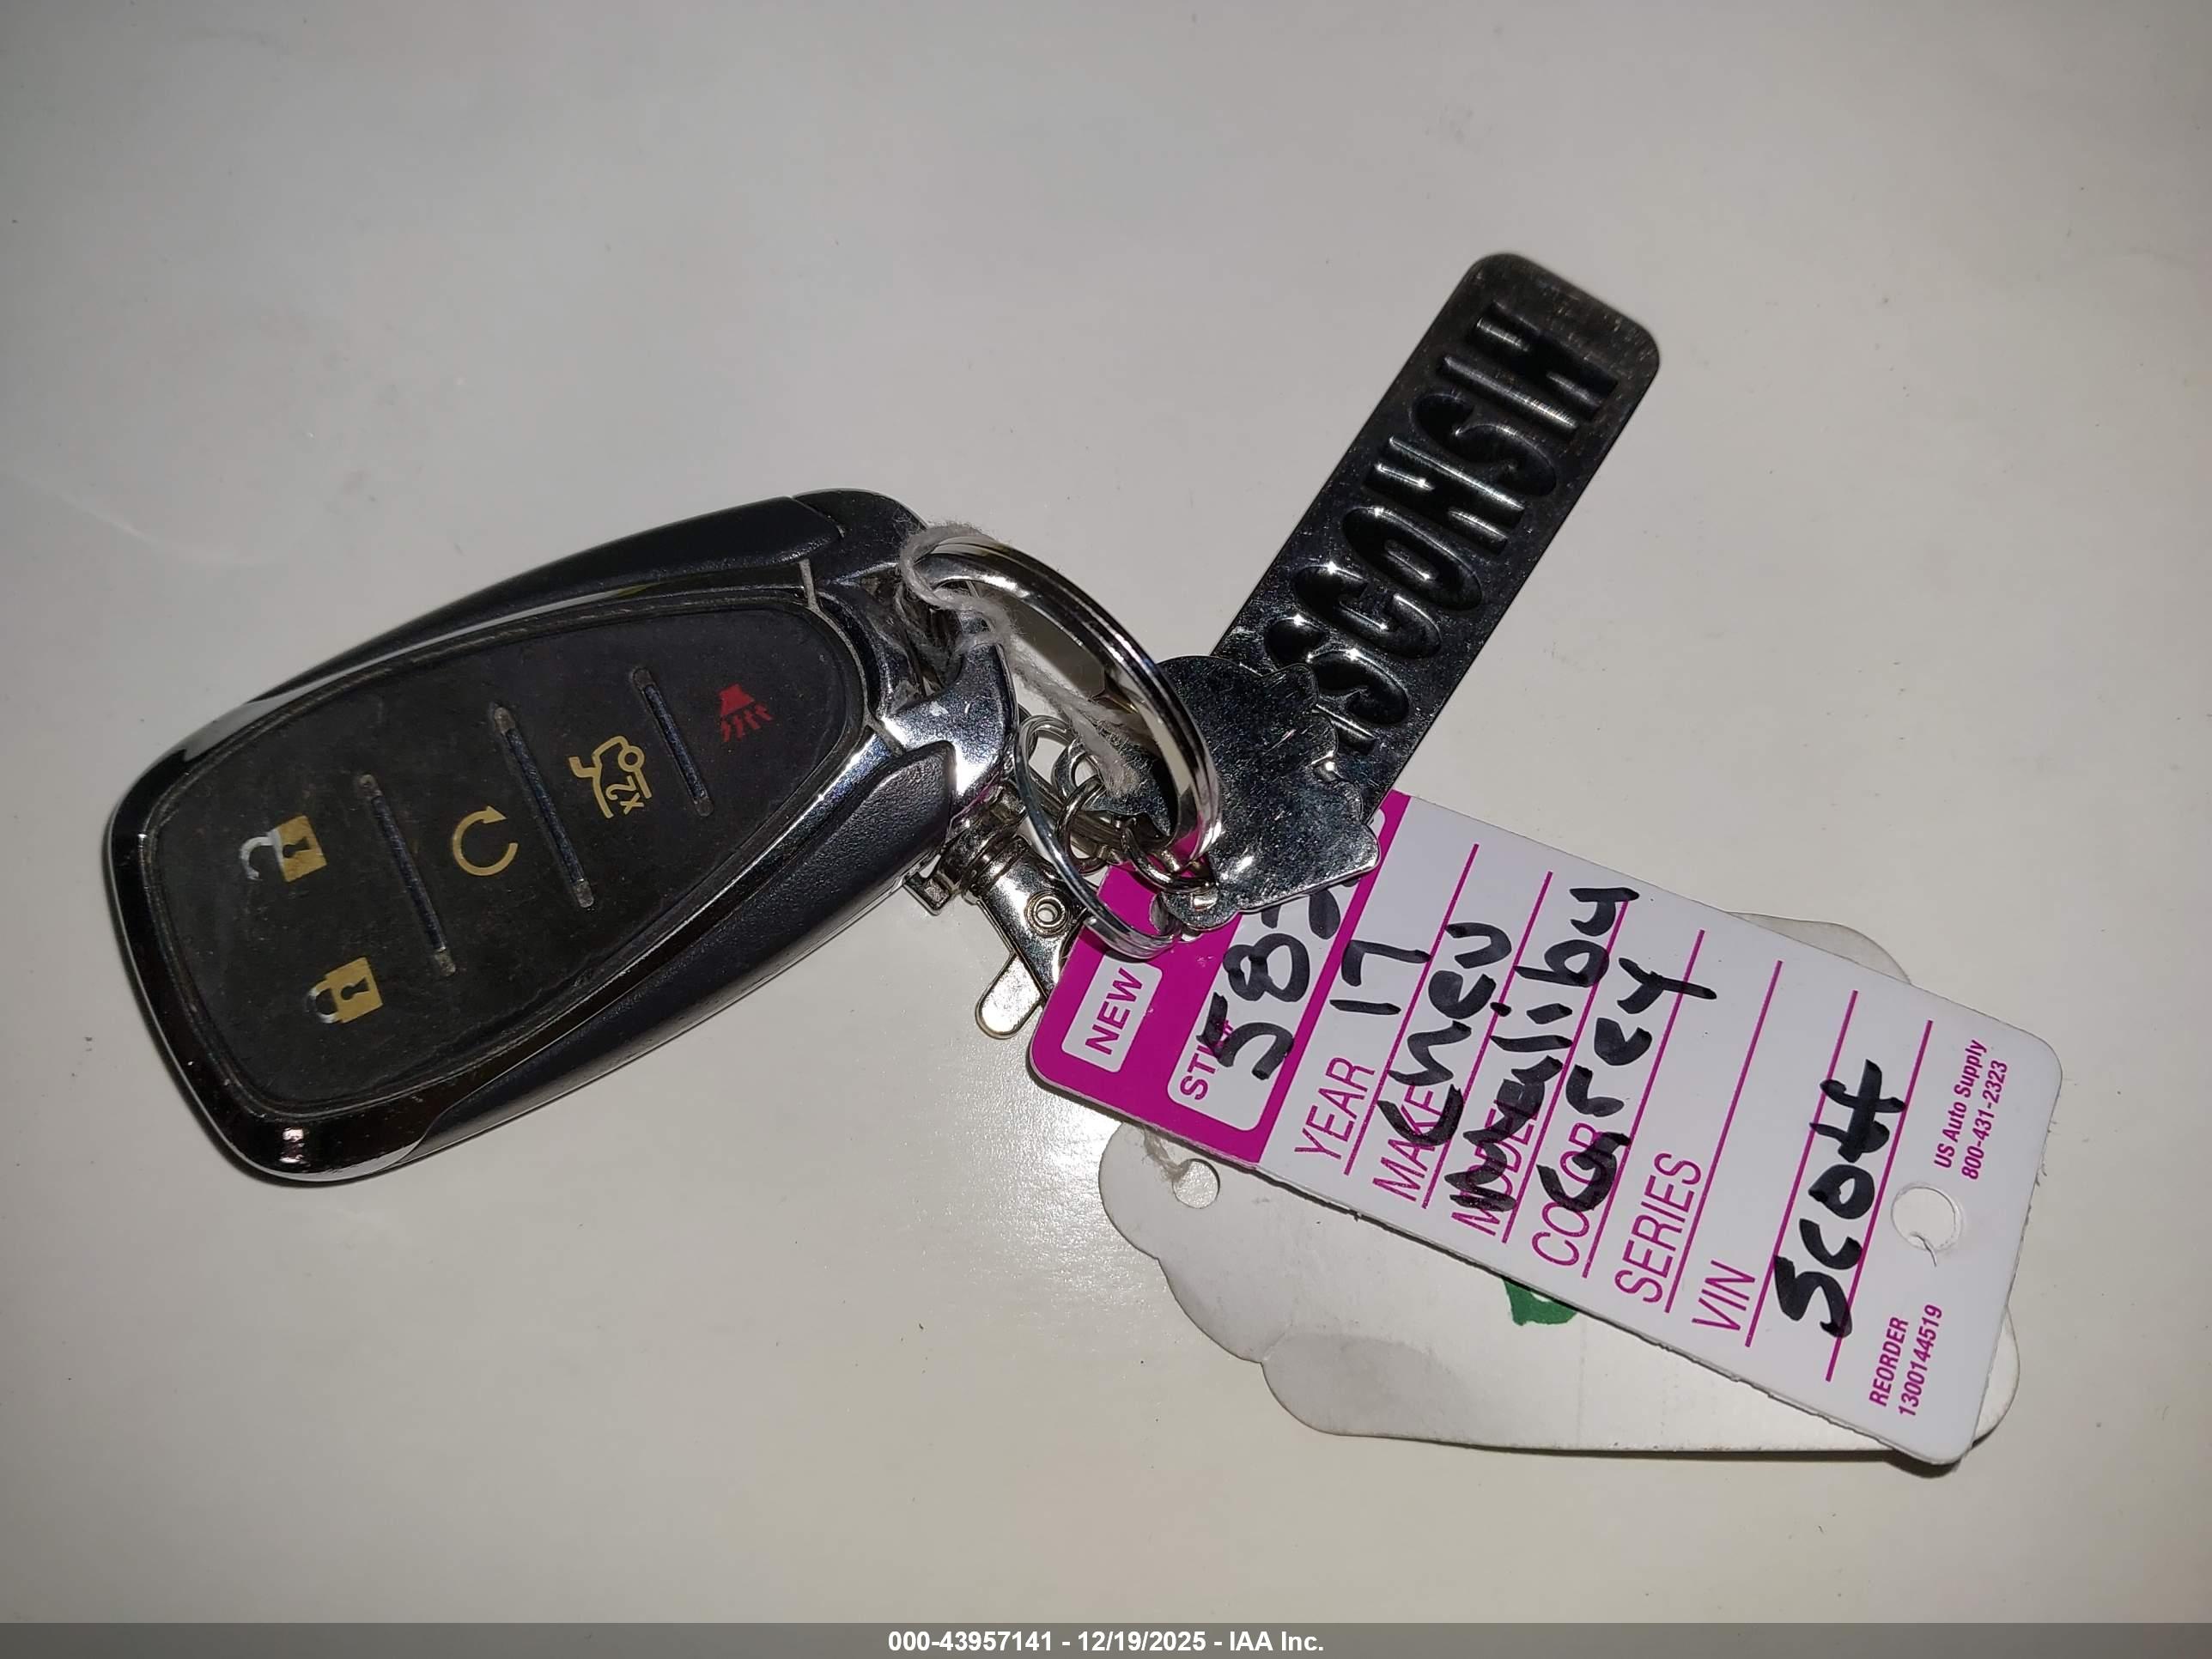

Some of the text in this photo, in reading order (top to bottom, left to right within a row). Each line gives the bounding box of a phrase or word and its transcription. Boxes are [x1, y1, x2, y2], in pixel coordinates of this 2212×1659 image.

[1085, 968, 1143, 1055] NEW
[1329, 939, 1432, 1015] 17
[1295, 1056, 1375, 1159] YEAR
[1372, 1084, 1443, 1201] MAKE
[1934, 1040, 1987, 1169] US Auto Supply
[1961, 1060, 2008, 1180] 800-431-2323
[1532, 1122, 1622, 1265] COOR
[1614, 1152, 1702, 1304] SERIES
[1692, 1260, 1756, 1331] VIN
[1869, 1316, 1908, 1407] REORDER
[1899, 1304, 1942, 1416] 1300144519
